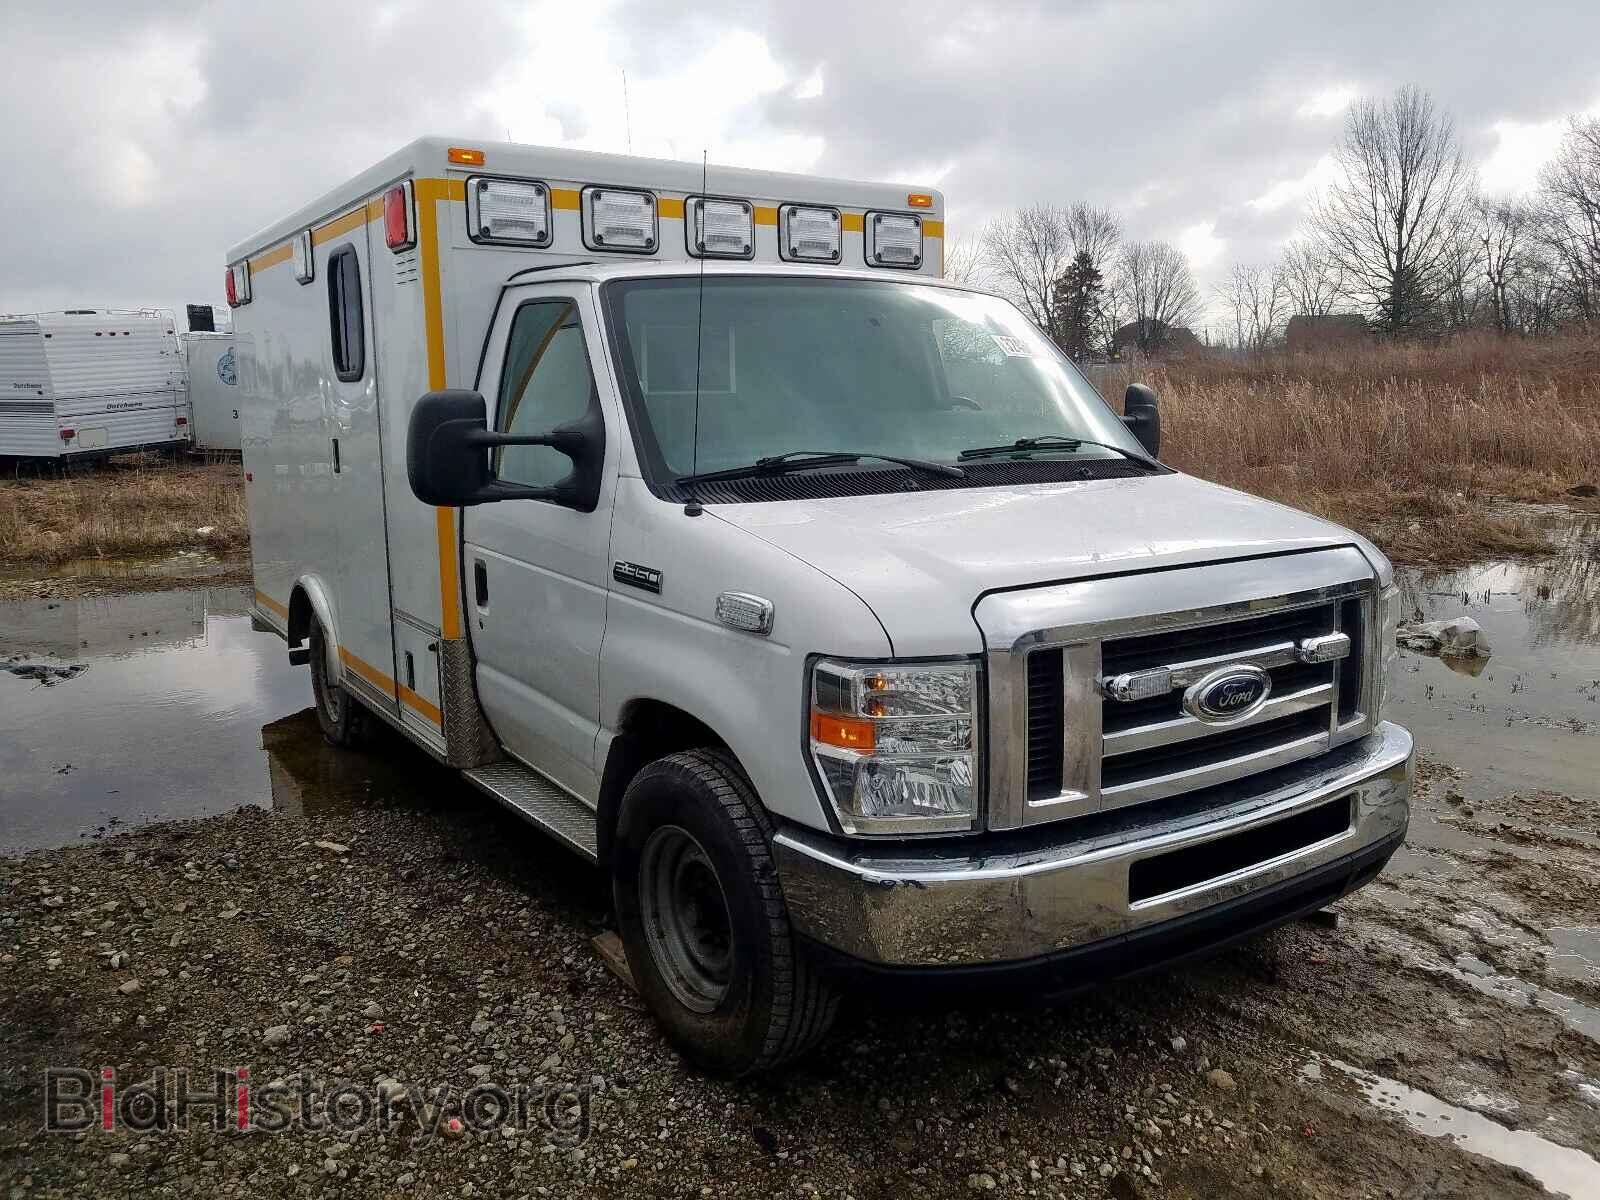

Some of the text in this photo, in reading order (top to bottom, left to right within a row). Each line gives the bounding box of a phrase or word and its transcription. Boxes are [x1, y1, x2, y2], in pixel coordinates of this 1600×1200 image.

[106, 402, 143, 410] Dutch
[232, 409, 239, 420] 3
[1219, 682, 1254, 708] Ford
